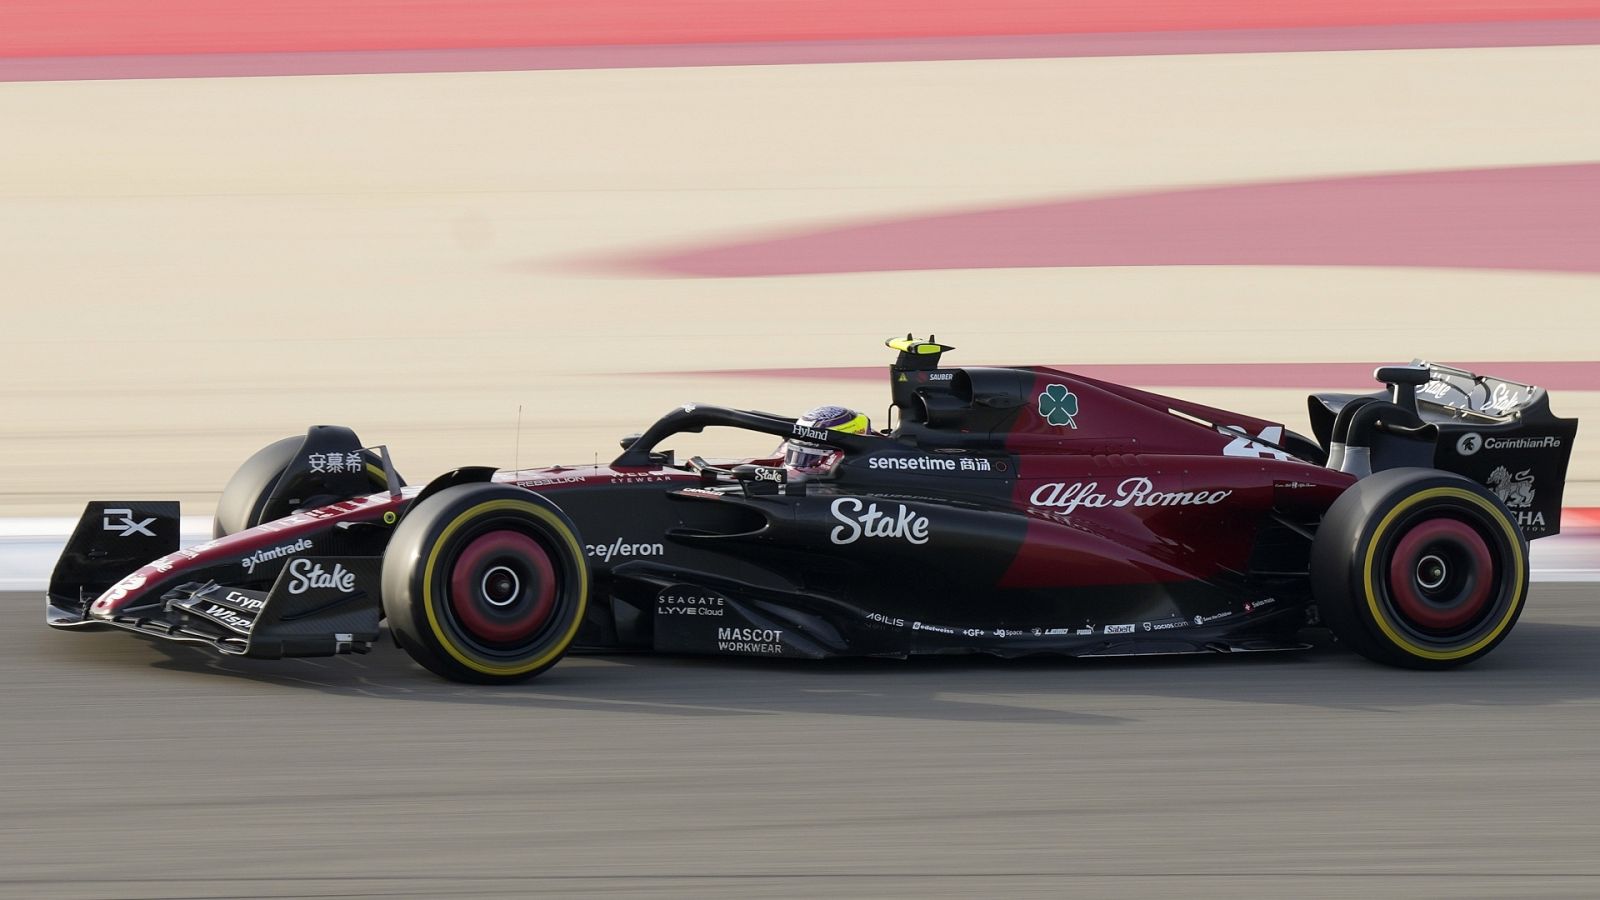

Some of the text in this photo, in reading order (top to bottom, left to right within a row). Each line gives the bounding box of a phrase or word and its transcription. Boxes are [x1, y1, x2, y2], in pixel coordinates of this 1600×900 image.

[929, 373, 953, 381] SAUBER
[792, 424, 828, 441] Hyland
[1217, 425, 1288, 461] 24
[308, 452, 362, 474] 安慕希
[869, 456, 956, 470] sensetime
[611, 476, 671, 484] EYEWEAR
[754, 468, 782, 483] Stake
[1030, 476, 1232, 516] Alfa Romeo
[830, 497, 929, 545] Stake
[241, 538, 313, 574] aximtrade
[288, 558, 356, 594] Stake
[225, 591, 266, 609] Cryp
[658, 595, 724, 606] SEAGATE
[658, 607, 723, 616] LYVE Cloud
[866, 612, 904, 627] AGILIS
[718, 627, 783, 642] MASCOT
[718, 641, 782, 653] WORKWEAR
